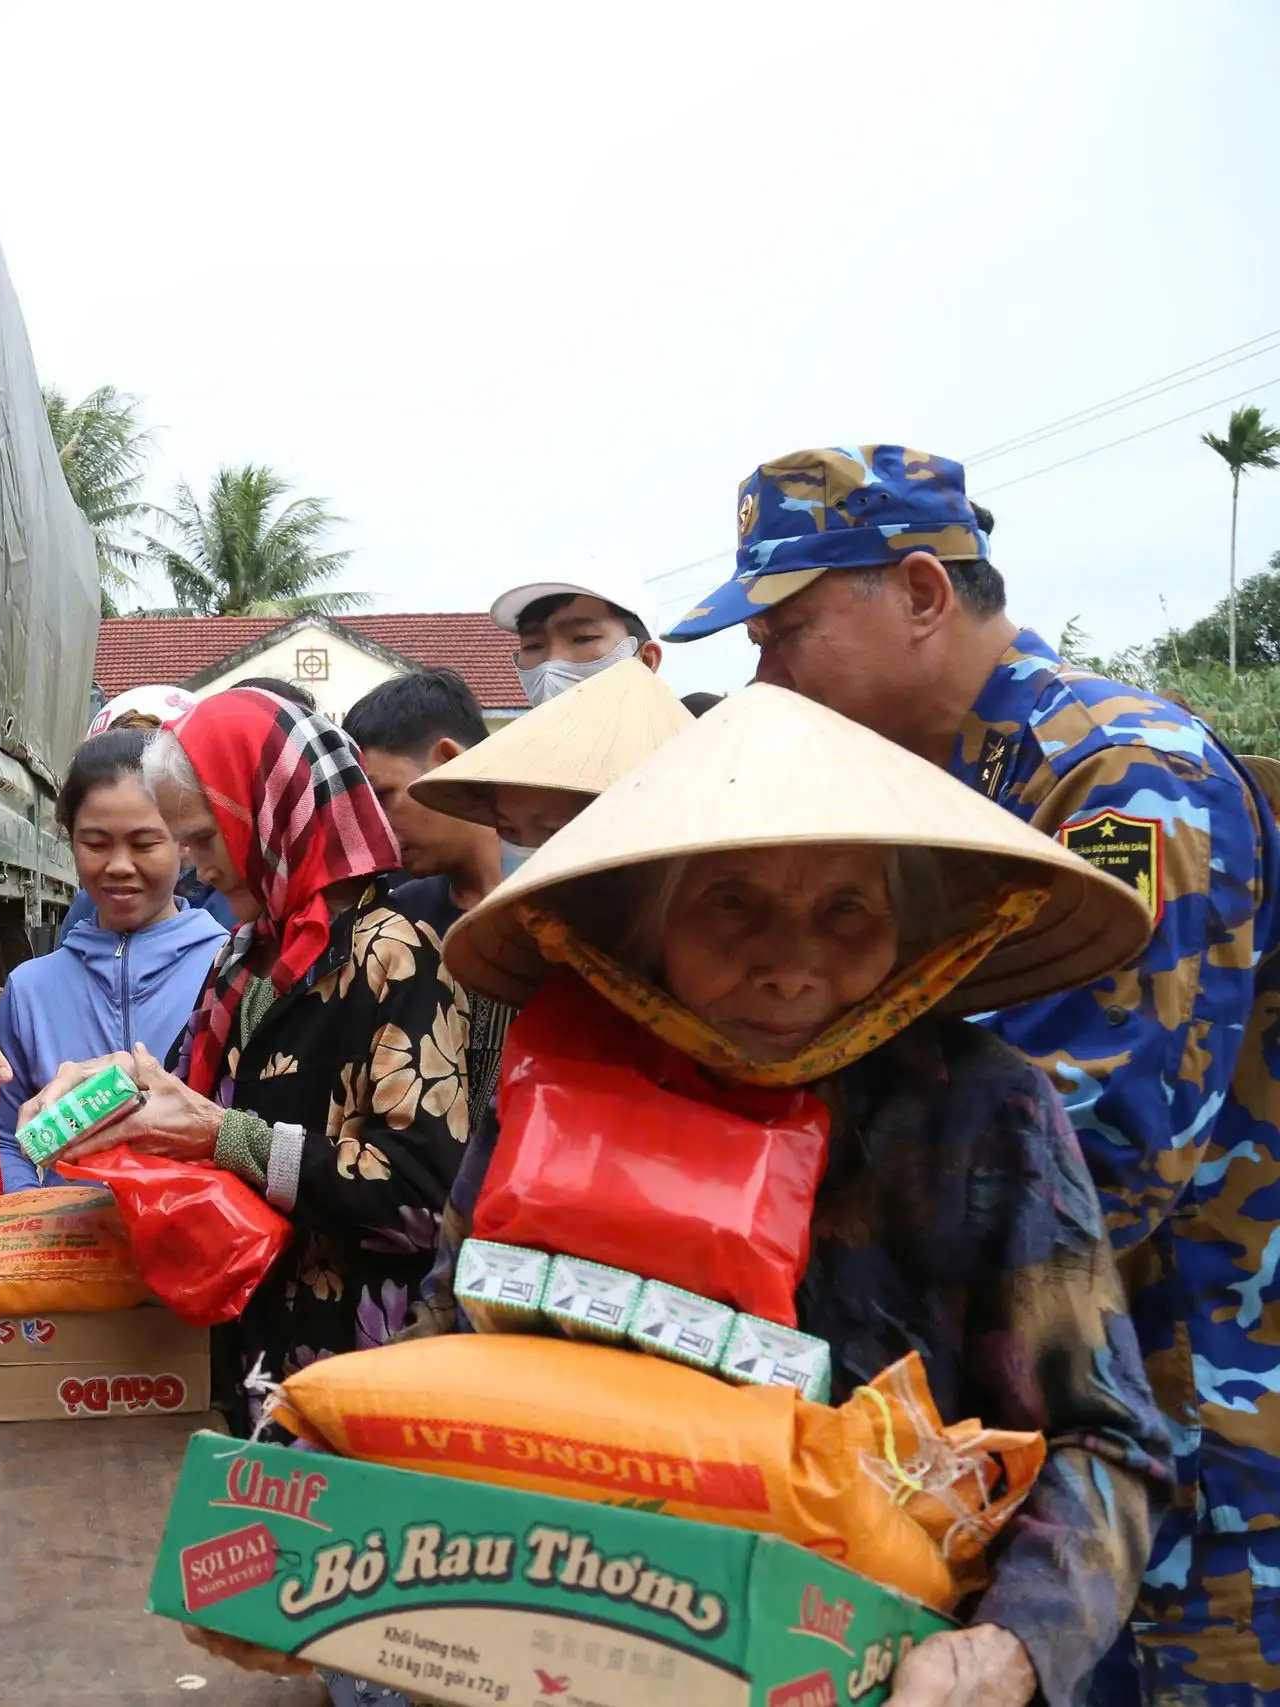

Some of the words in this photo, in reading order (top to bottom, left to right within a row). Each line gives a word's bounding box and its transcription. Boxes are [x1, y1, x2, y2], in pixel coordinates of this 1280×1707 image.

[226, 1457, 329, 1521] Unif
[190, 1551, 226, 1581] SỢI
[227, 1534, 268, 1567] DAI
[395, 1525, 514, 1581] Rau
[526, 1525, 722, 1633] Thơm
